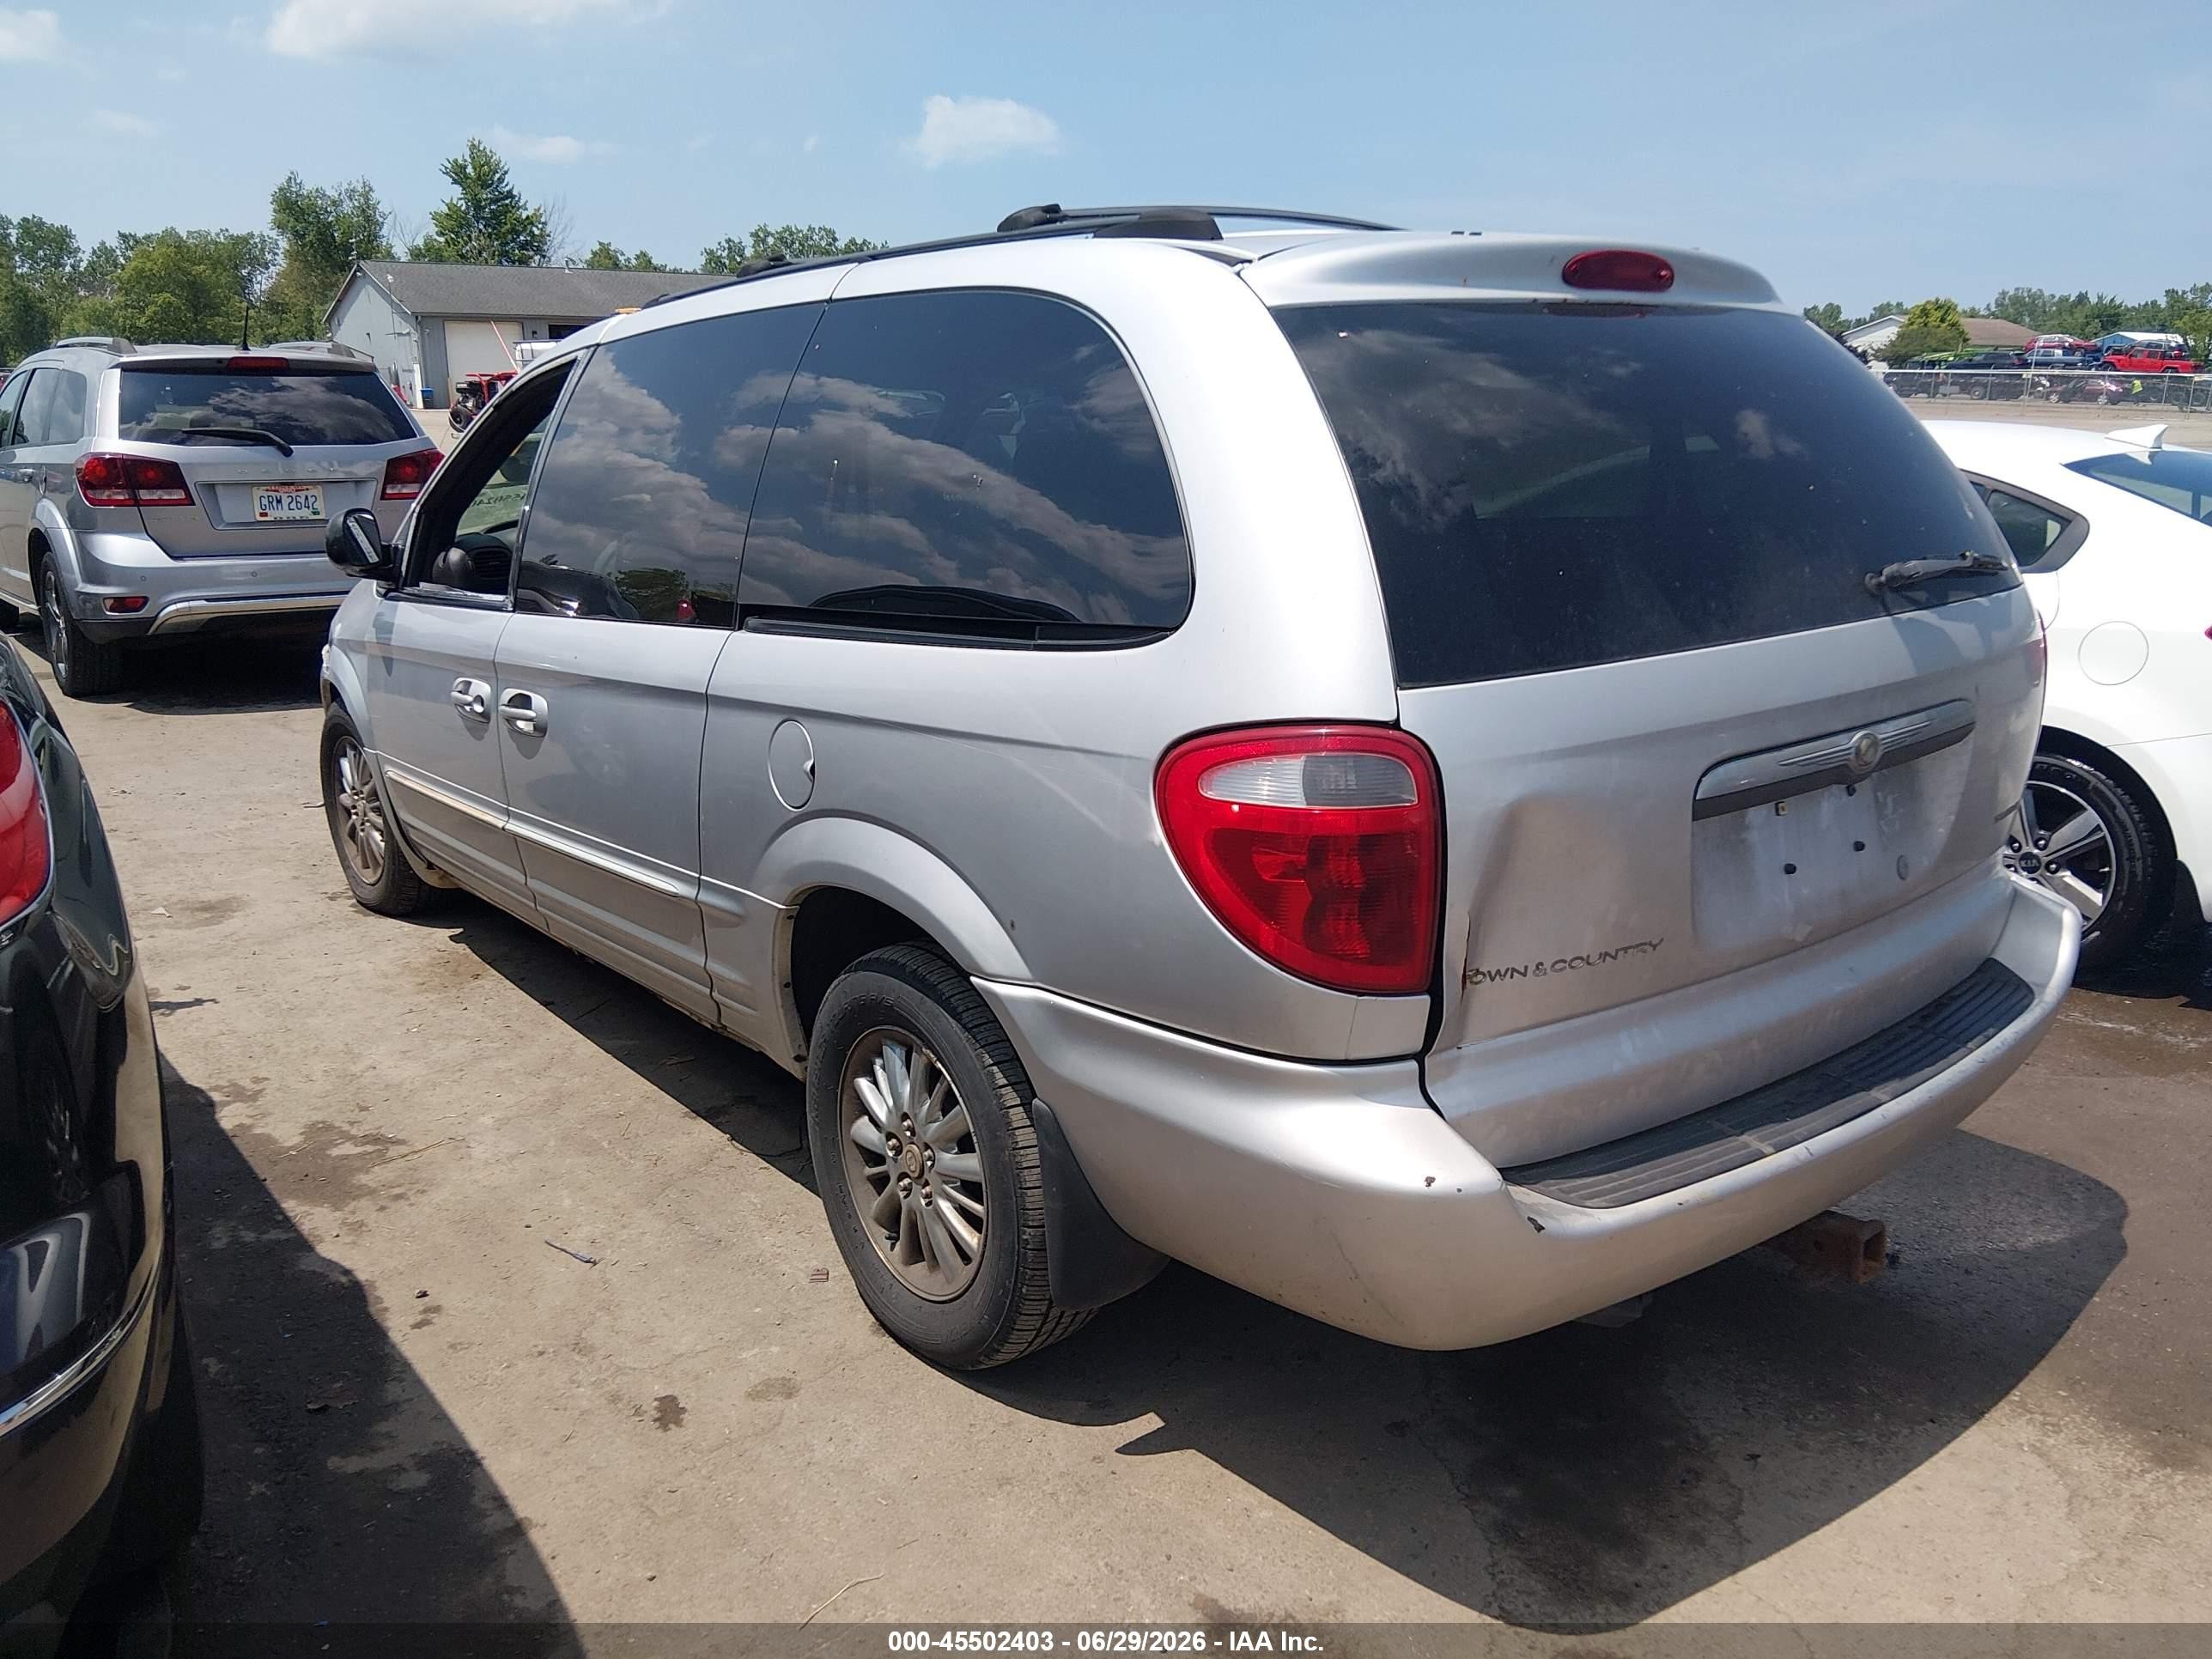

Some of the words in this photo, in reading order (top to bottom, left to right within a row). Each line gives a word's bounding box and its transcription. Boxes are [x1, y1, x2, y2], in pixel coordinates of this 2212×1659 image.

[259, 495, 284, 511] GRM
[288, 494, 319, 511] 2642
[1549, 938, 1664, 974] COUNTRY
